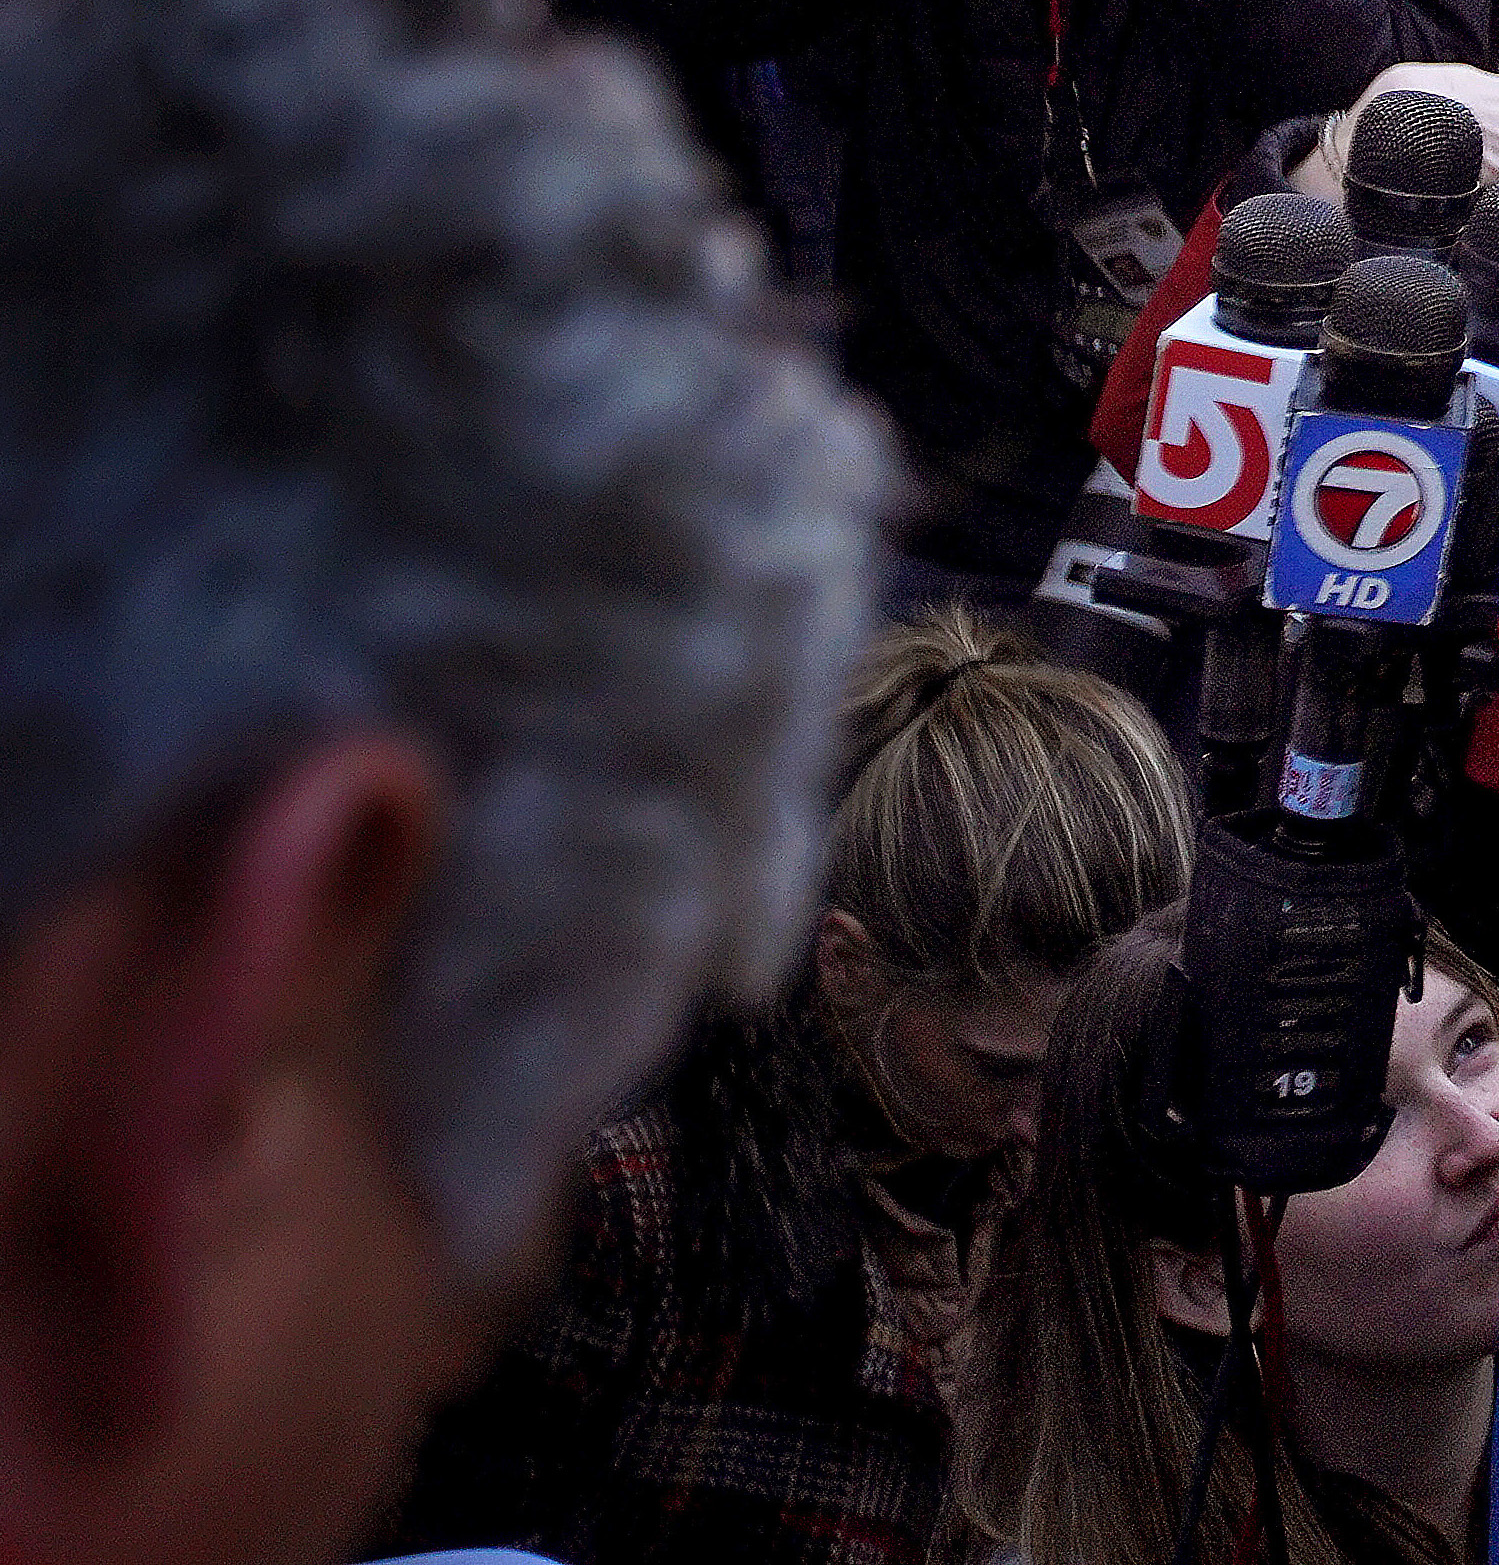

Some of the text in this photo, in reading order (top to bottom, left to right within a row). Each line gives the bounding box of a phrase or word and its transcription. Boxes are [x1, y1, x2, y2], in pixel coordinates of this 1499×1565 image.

[1135, 345, 1272, 523] 5
[1320, 465, 1424, 549] 7
[1315, 573, 1392, 609] HD
[1272, 1071, 1316, 1098] 19
